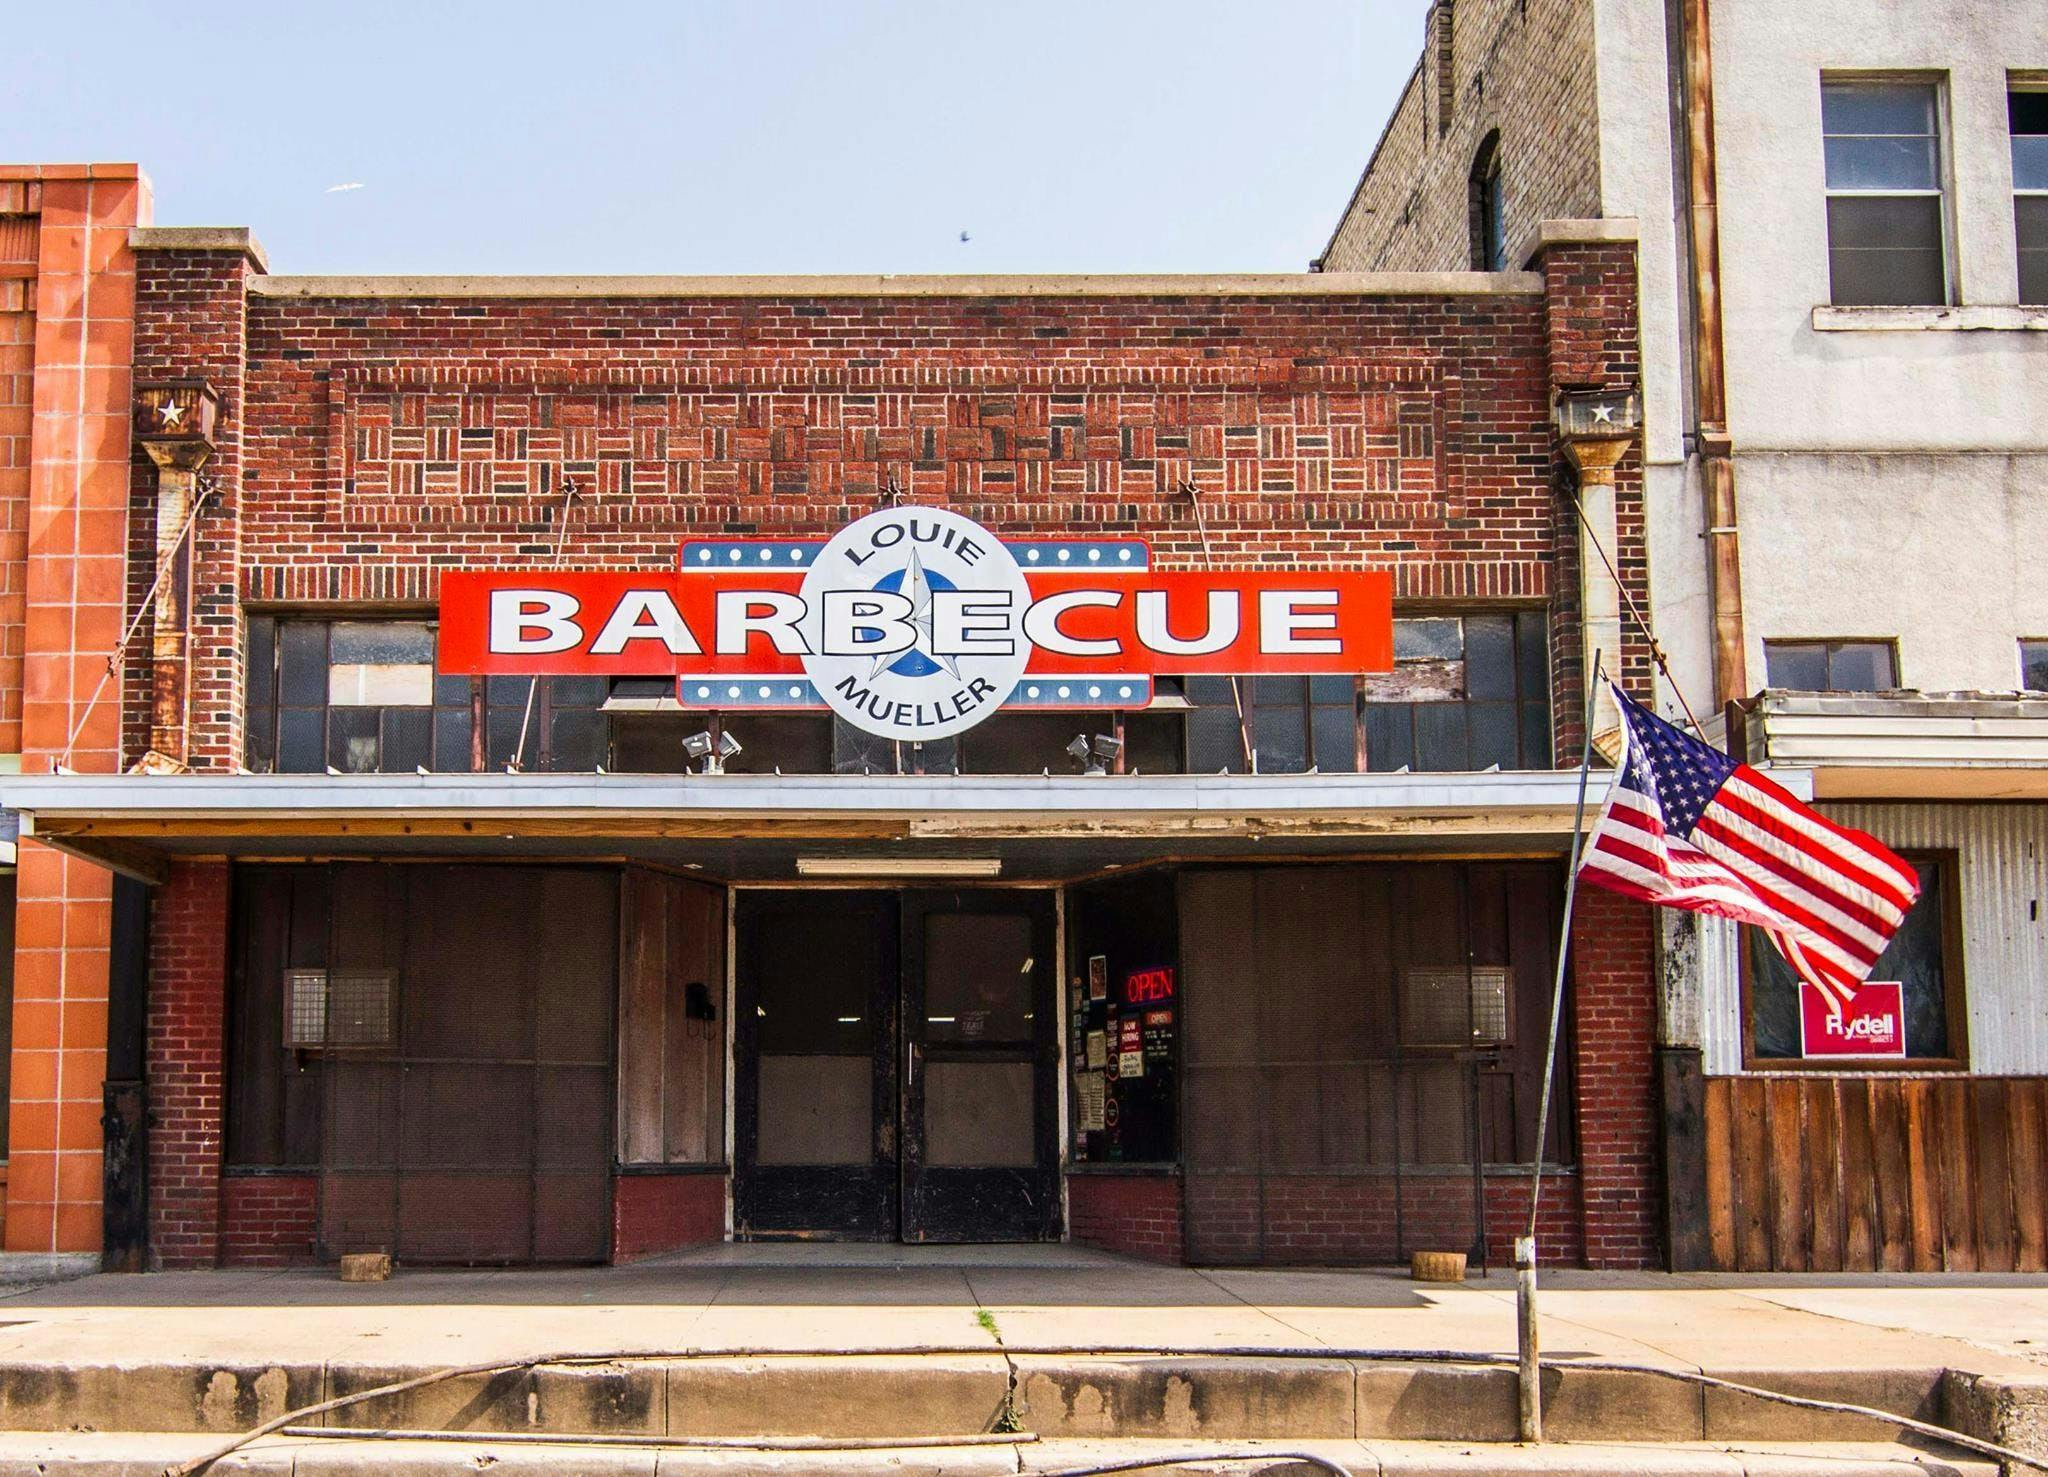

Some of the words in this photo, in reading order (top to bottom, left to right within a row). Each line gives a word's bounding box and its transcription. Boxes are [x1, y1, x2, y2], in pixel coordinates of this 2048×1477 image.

[844, 519, 986, 567] LOUIE
[488, 589, 1344, 656] BARBECUE
[834, 675, 997, 726] MUELLER
[1127, 968, 1174, 1002] OPEN
[1121, 1032, 1140, 1043] HIRING
[1123, 1020, 1137, 1032] NOW
[1825, 1014, 1894, 1040] Rydell
